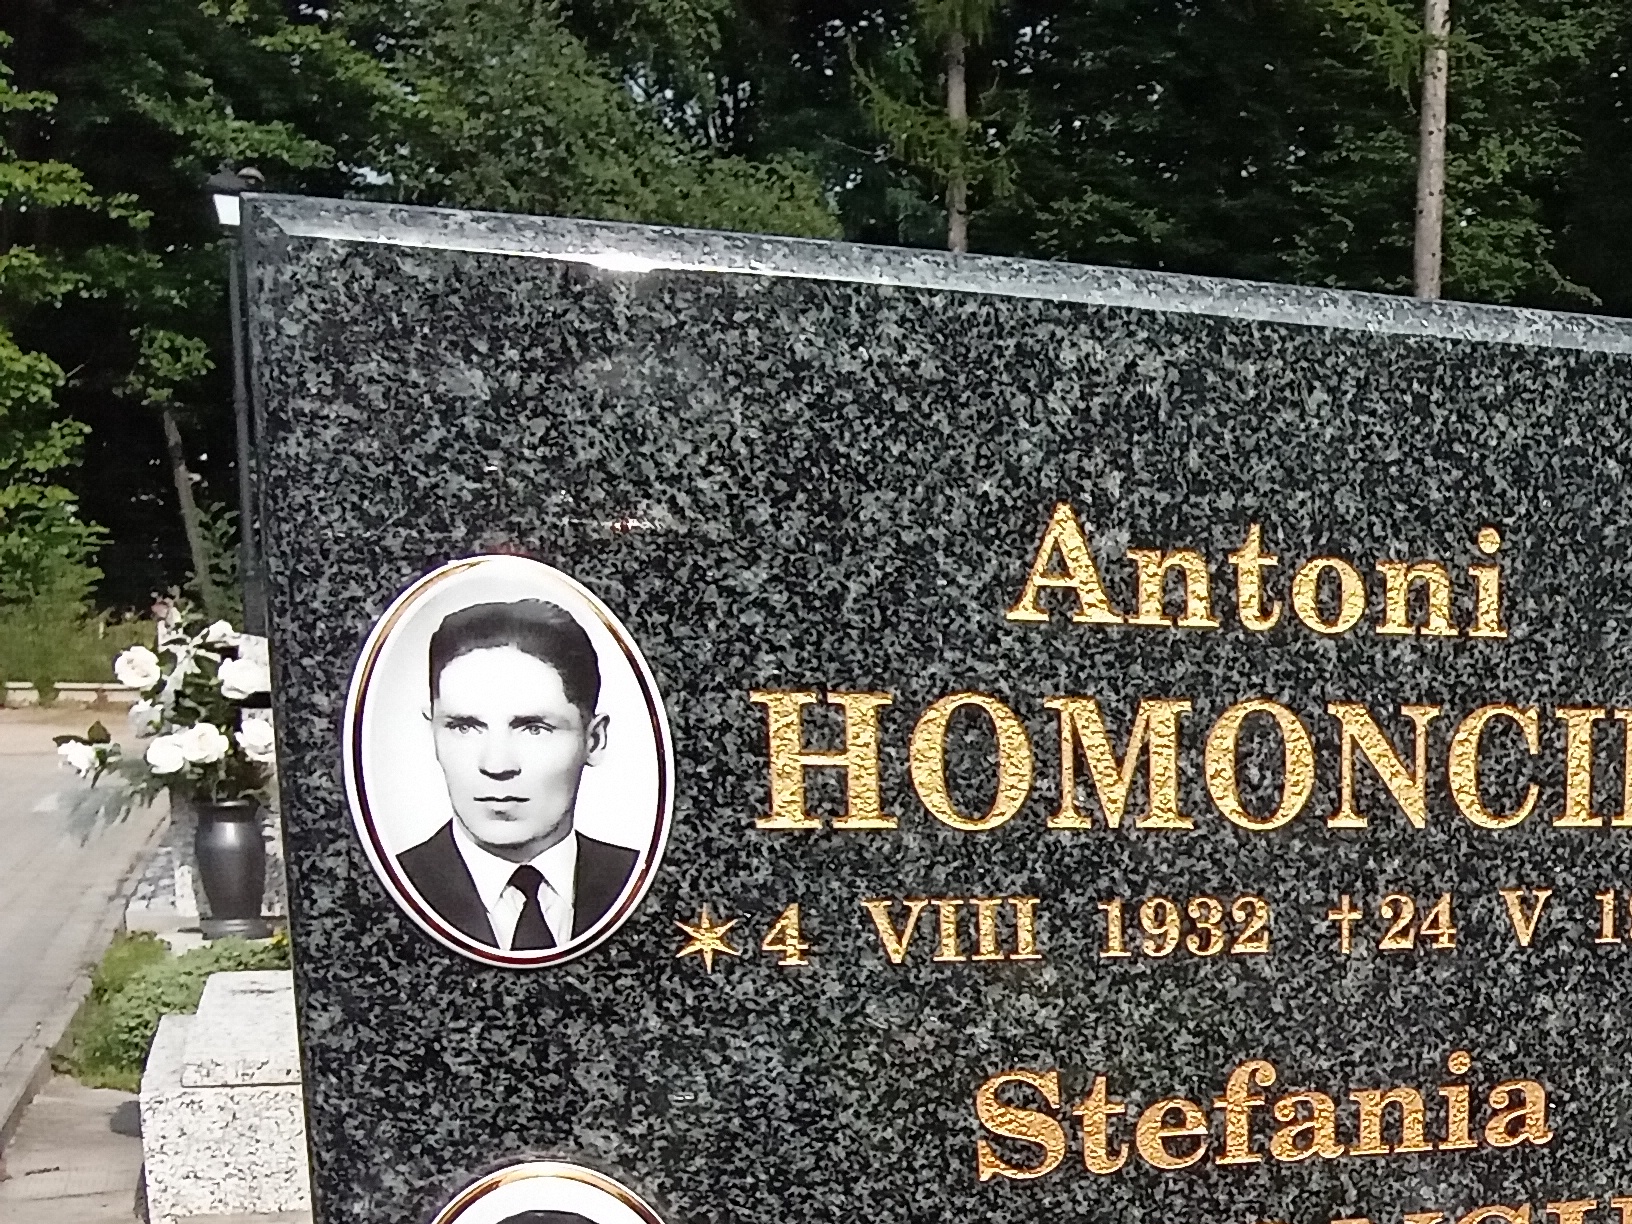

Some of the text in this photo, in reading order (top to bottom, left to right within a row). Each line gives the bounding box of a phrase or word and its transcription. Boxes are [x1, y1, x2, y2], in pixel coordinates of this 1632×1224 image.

[1006, 501, 1508, 638] Antoni
[761, 901, 810, 966] 4
[860, 896, 1043, 964] VIII
[1097, 895, 1270, 958] 1932
[1499, 887, 1553, 947] V
[975, 1049, 1554, 1183] Stefania
